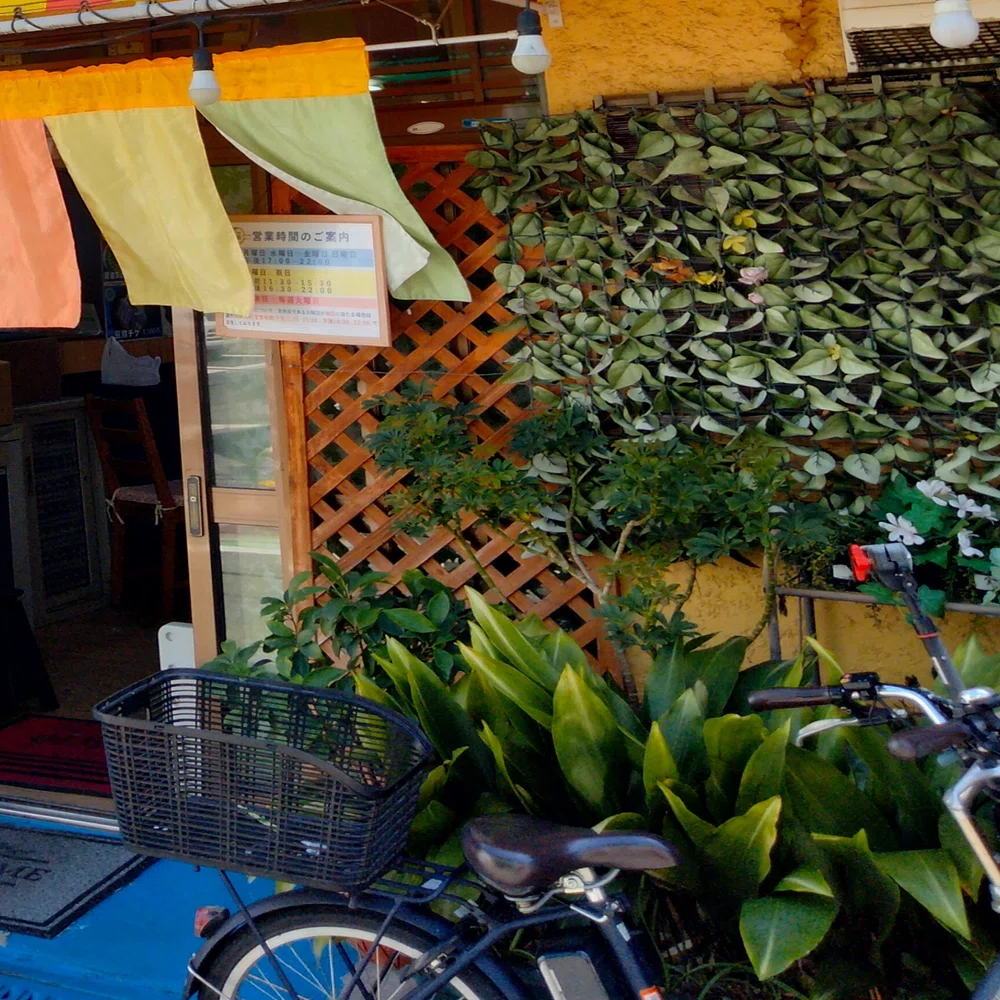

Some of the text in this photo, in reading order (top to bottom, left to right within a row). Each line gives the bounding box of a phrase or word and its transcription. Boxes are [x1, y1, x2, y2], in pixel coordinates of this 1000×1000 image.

[252, 231, 350, 243] 営業時間のご案内
